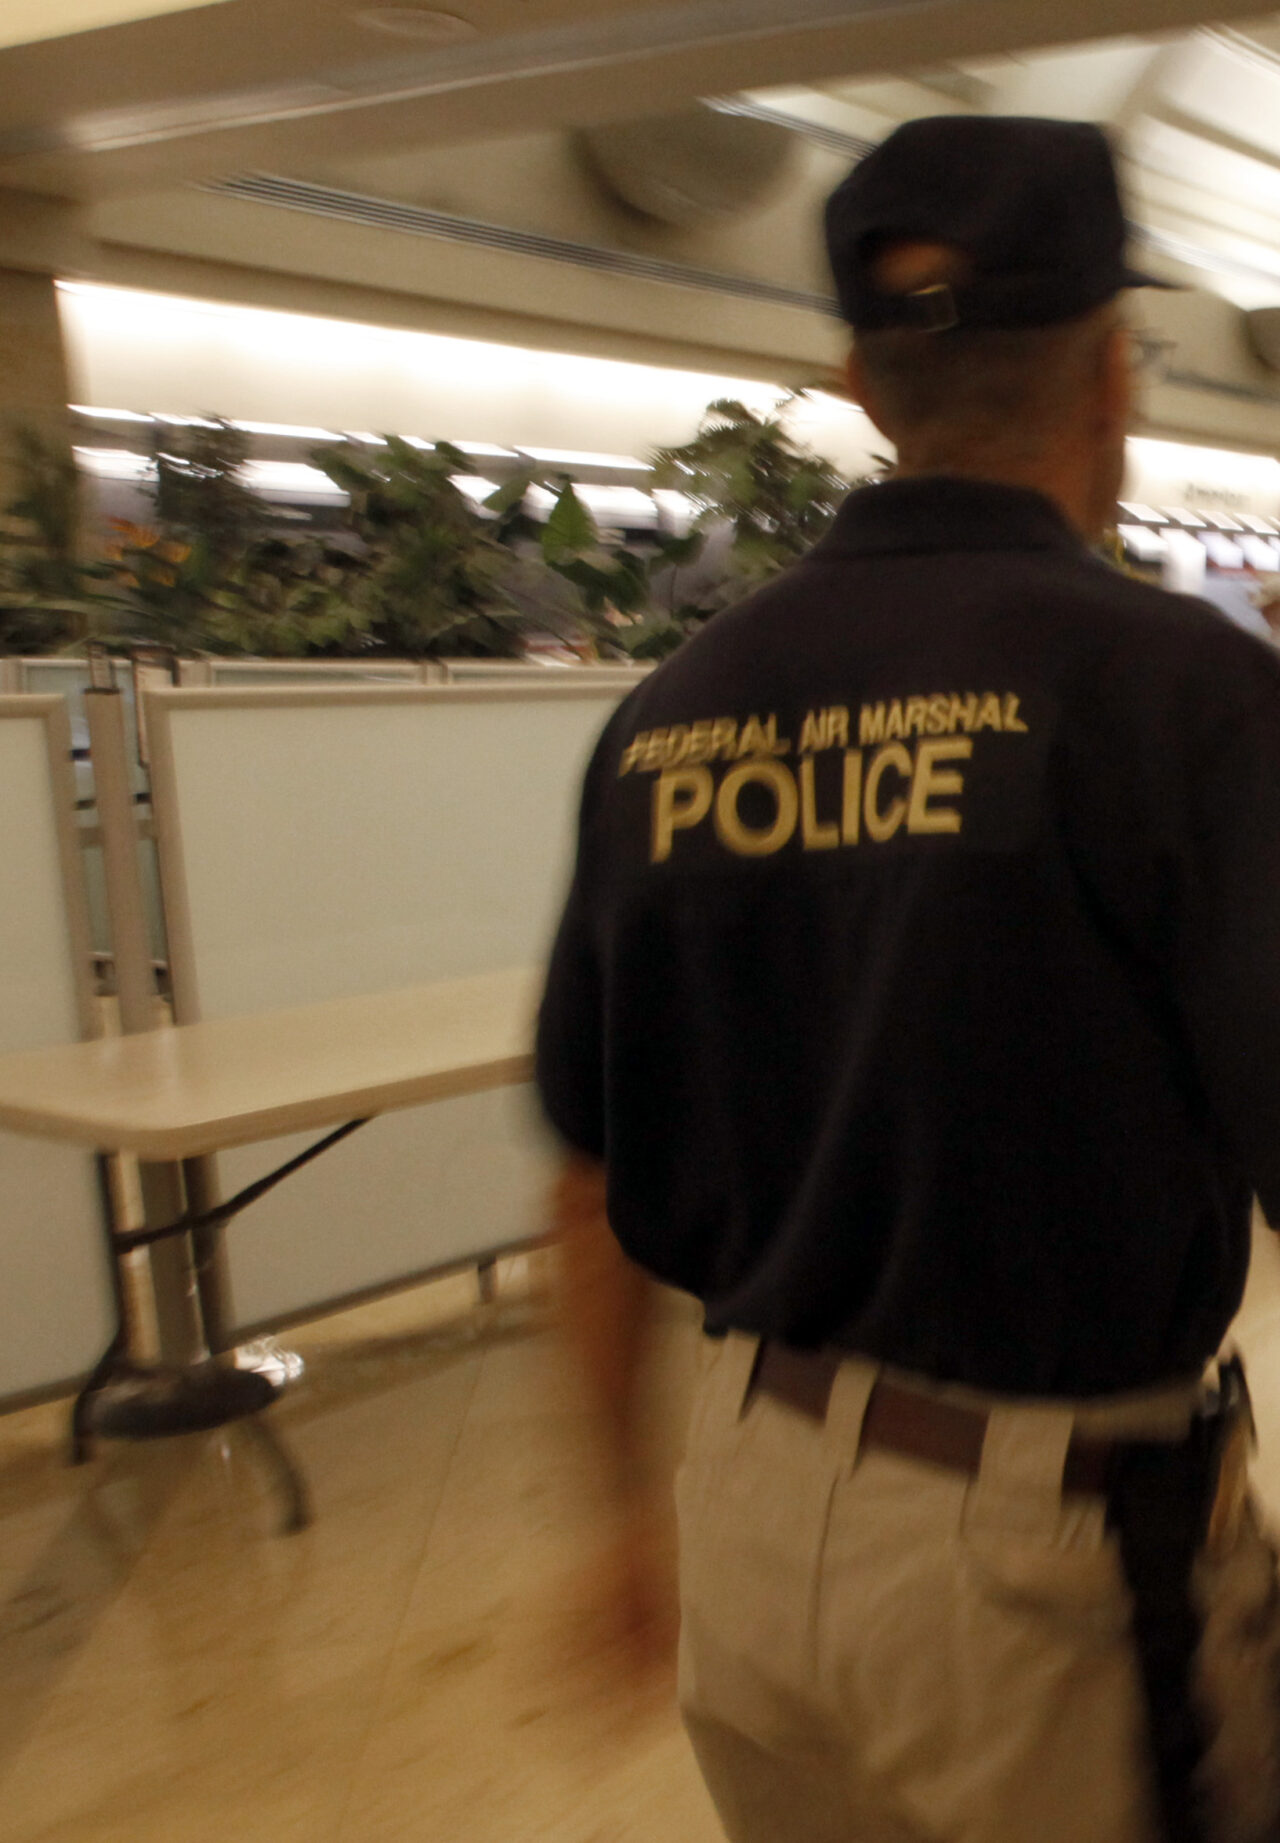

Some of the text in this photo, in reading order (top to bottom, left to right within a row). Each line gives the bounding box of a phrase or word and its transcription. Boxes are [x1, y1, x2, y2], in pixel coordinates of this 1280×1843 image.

[620, 692, 1029, 777] FEDERAL AIR MARSHAL
[651, 736, 973, 864] POLICE
